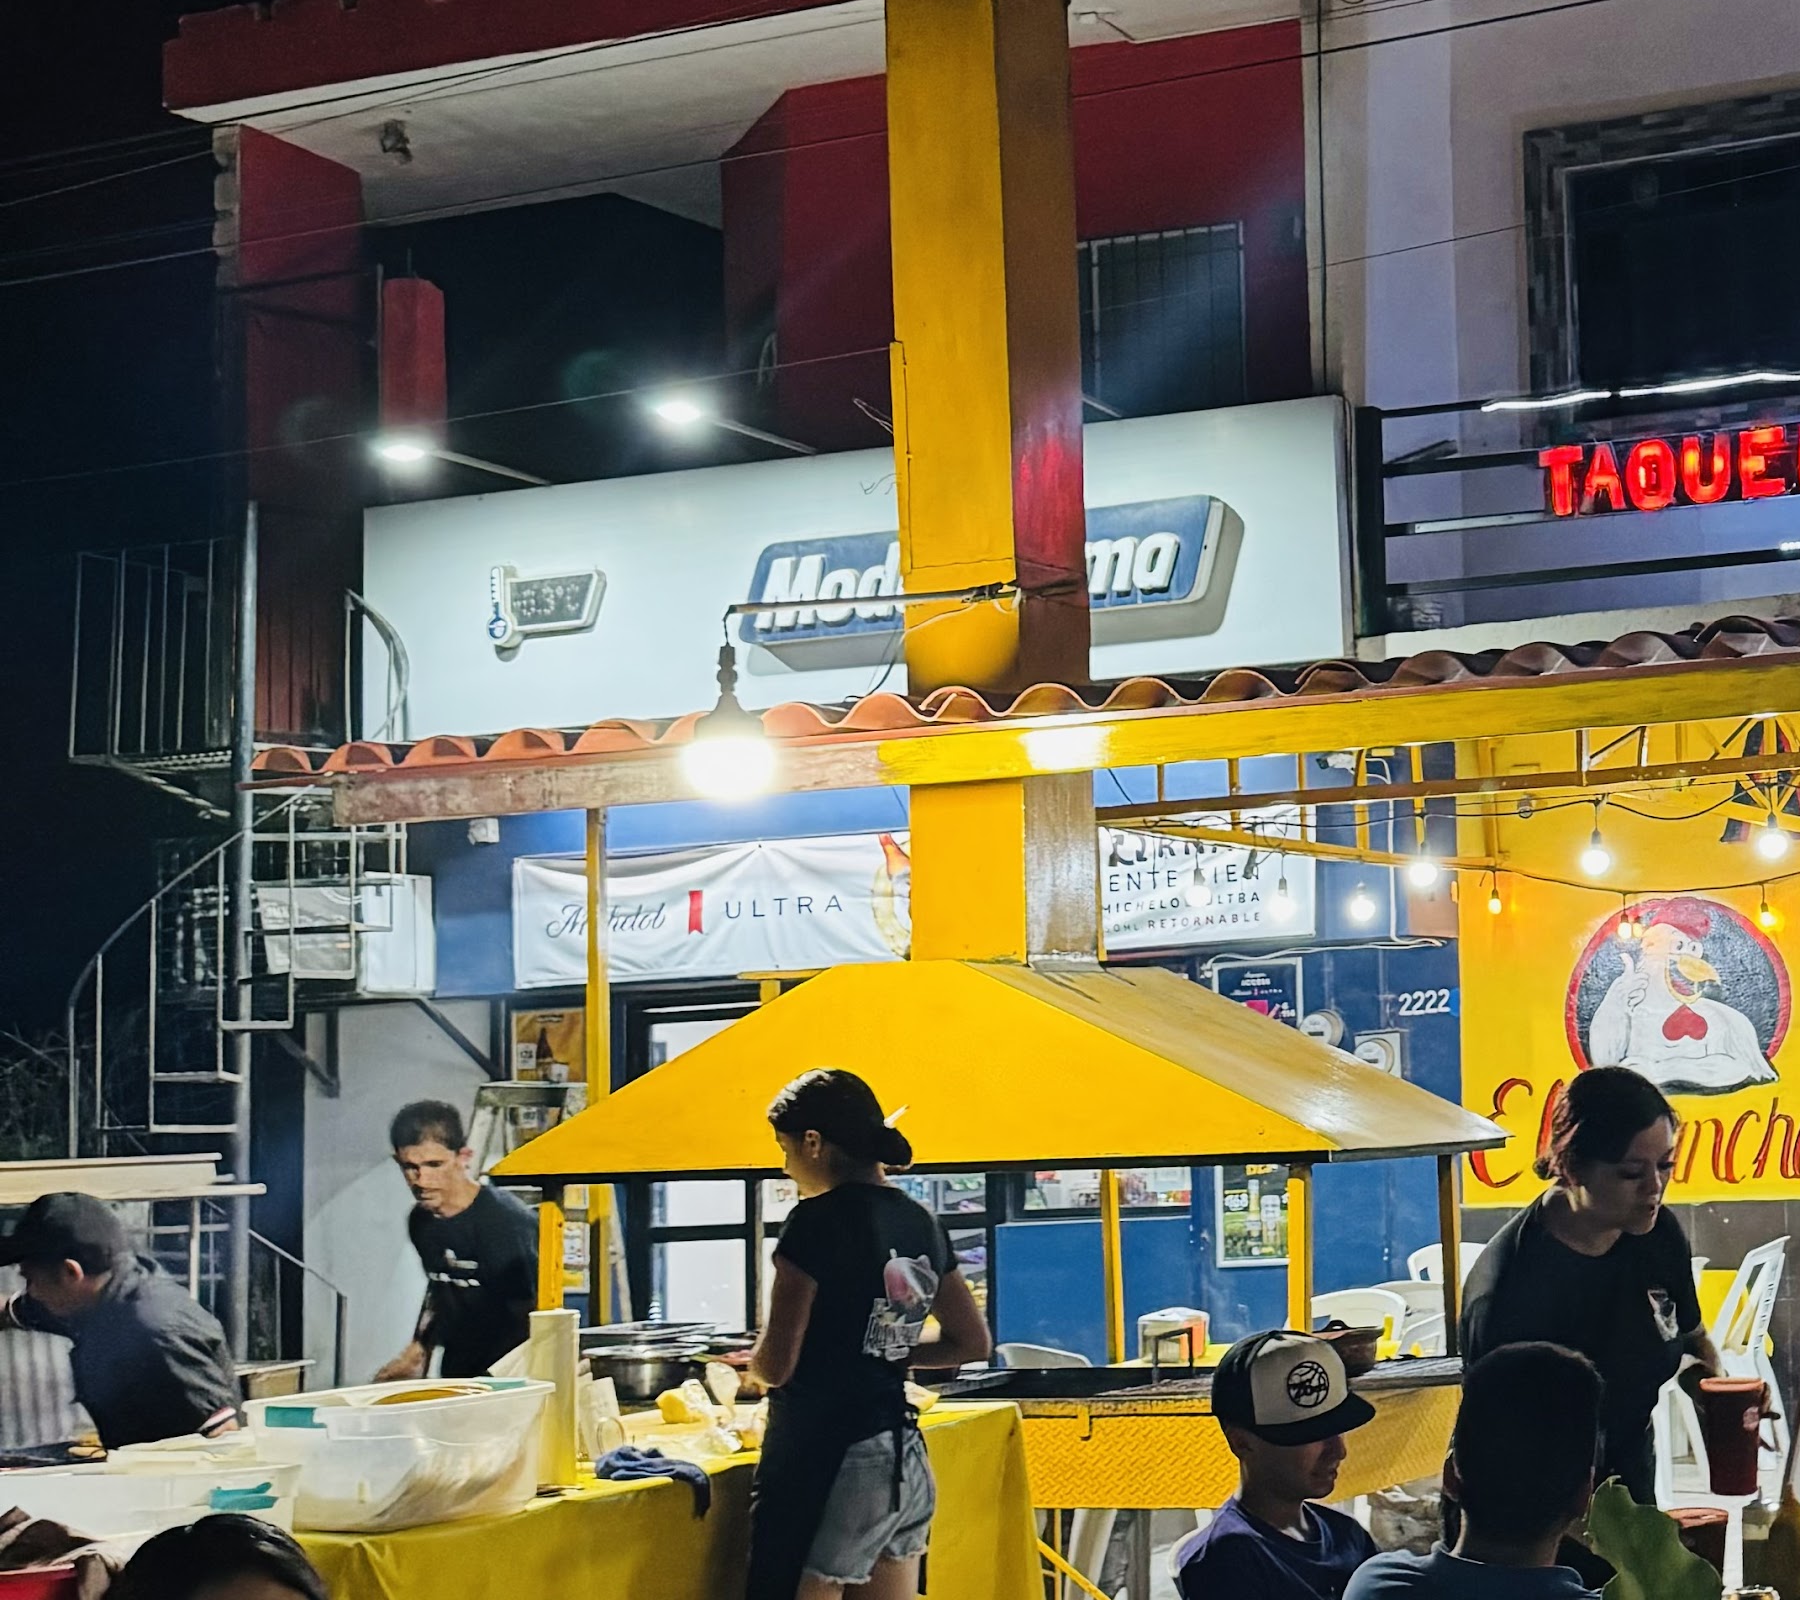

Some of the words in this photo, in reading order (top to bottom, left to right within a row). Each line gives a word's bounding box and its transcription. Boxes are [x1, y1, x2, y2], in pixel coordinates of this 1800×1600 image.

[545, 902, 666, 939] Mihelob
[724, 894, 843, 920] ULTRA
[1148, 911, 1261, 930] RETORNABLE
[1398, 988, 1452, 1016] 2222
